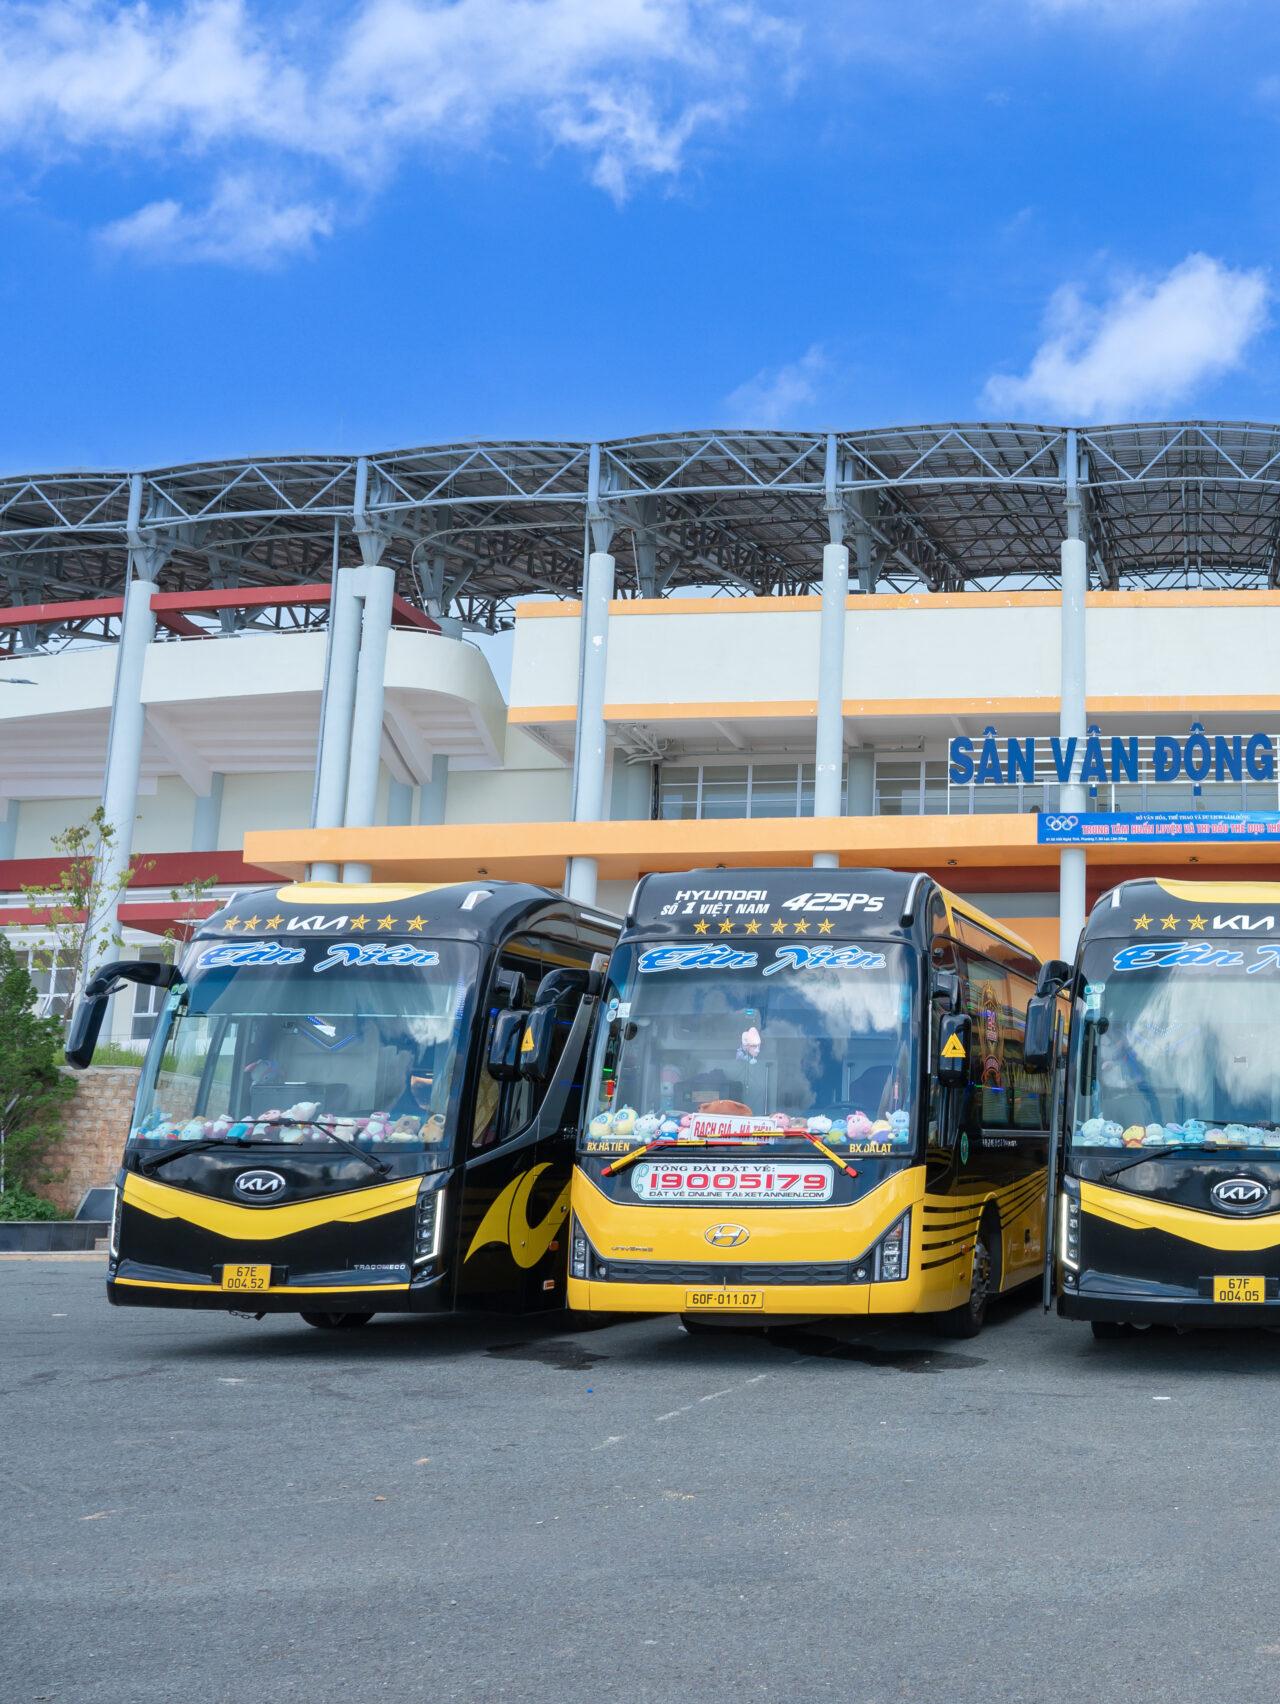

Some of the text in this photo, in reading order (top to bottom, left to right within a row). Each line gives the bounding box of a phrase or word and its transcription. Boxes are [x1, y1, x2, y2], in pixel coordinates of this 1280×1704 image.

[949, 725, 1036, 785] SÂN
[1050, 723, 1139, 798] VẬN
[1152, 722, 1275, 797] ĐỘNG
[1082, 824, 1110, 835] TRUNG
[1111, 822, 1129, 835] TÂM
[1131, 821, 1154, 834] HUẤN
[1156, 822, 1182, 836] LUYỆN
[1184, 821, 1195, 833] VÀ
[1197, 823, 1209, 833] THI
[675, 890, 768, 901] HYUNDAI
[660, 899, 771, 918] SỐ 1 VIỆT NAM
[286, 915, 349, 931] KIA
[1212, 914, 1275, 931] KIA
[693, 1164, 716, 1172] ĐÀI
[239, 1178, 280, 1191] KIA
[650, 1173, 827, 1190] 19005179
[1219, 1186, 1262, 1200] KIA
[236, 1266, 257, 1278] 67E
[227, 1278, 264, 1289] 004.52
[1228, 1278, 1250, 1289] 67F
[692, 1293, 757, 1305] 60F-011.07
[1219, 1290, 1259, 1302] 004.05
